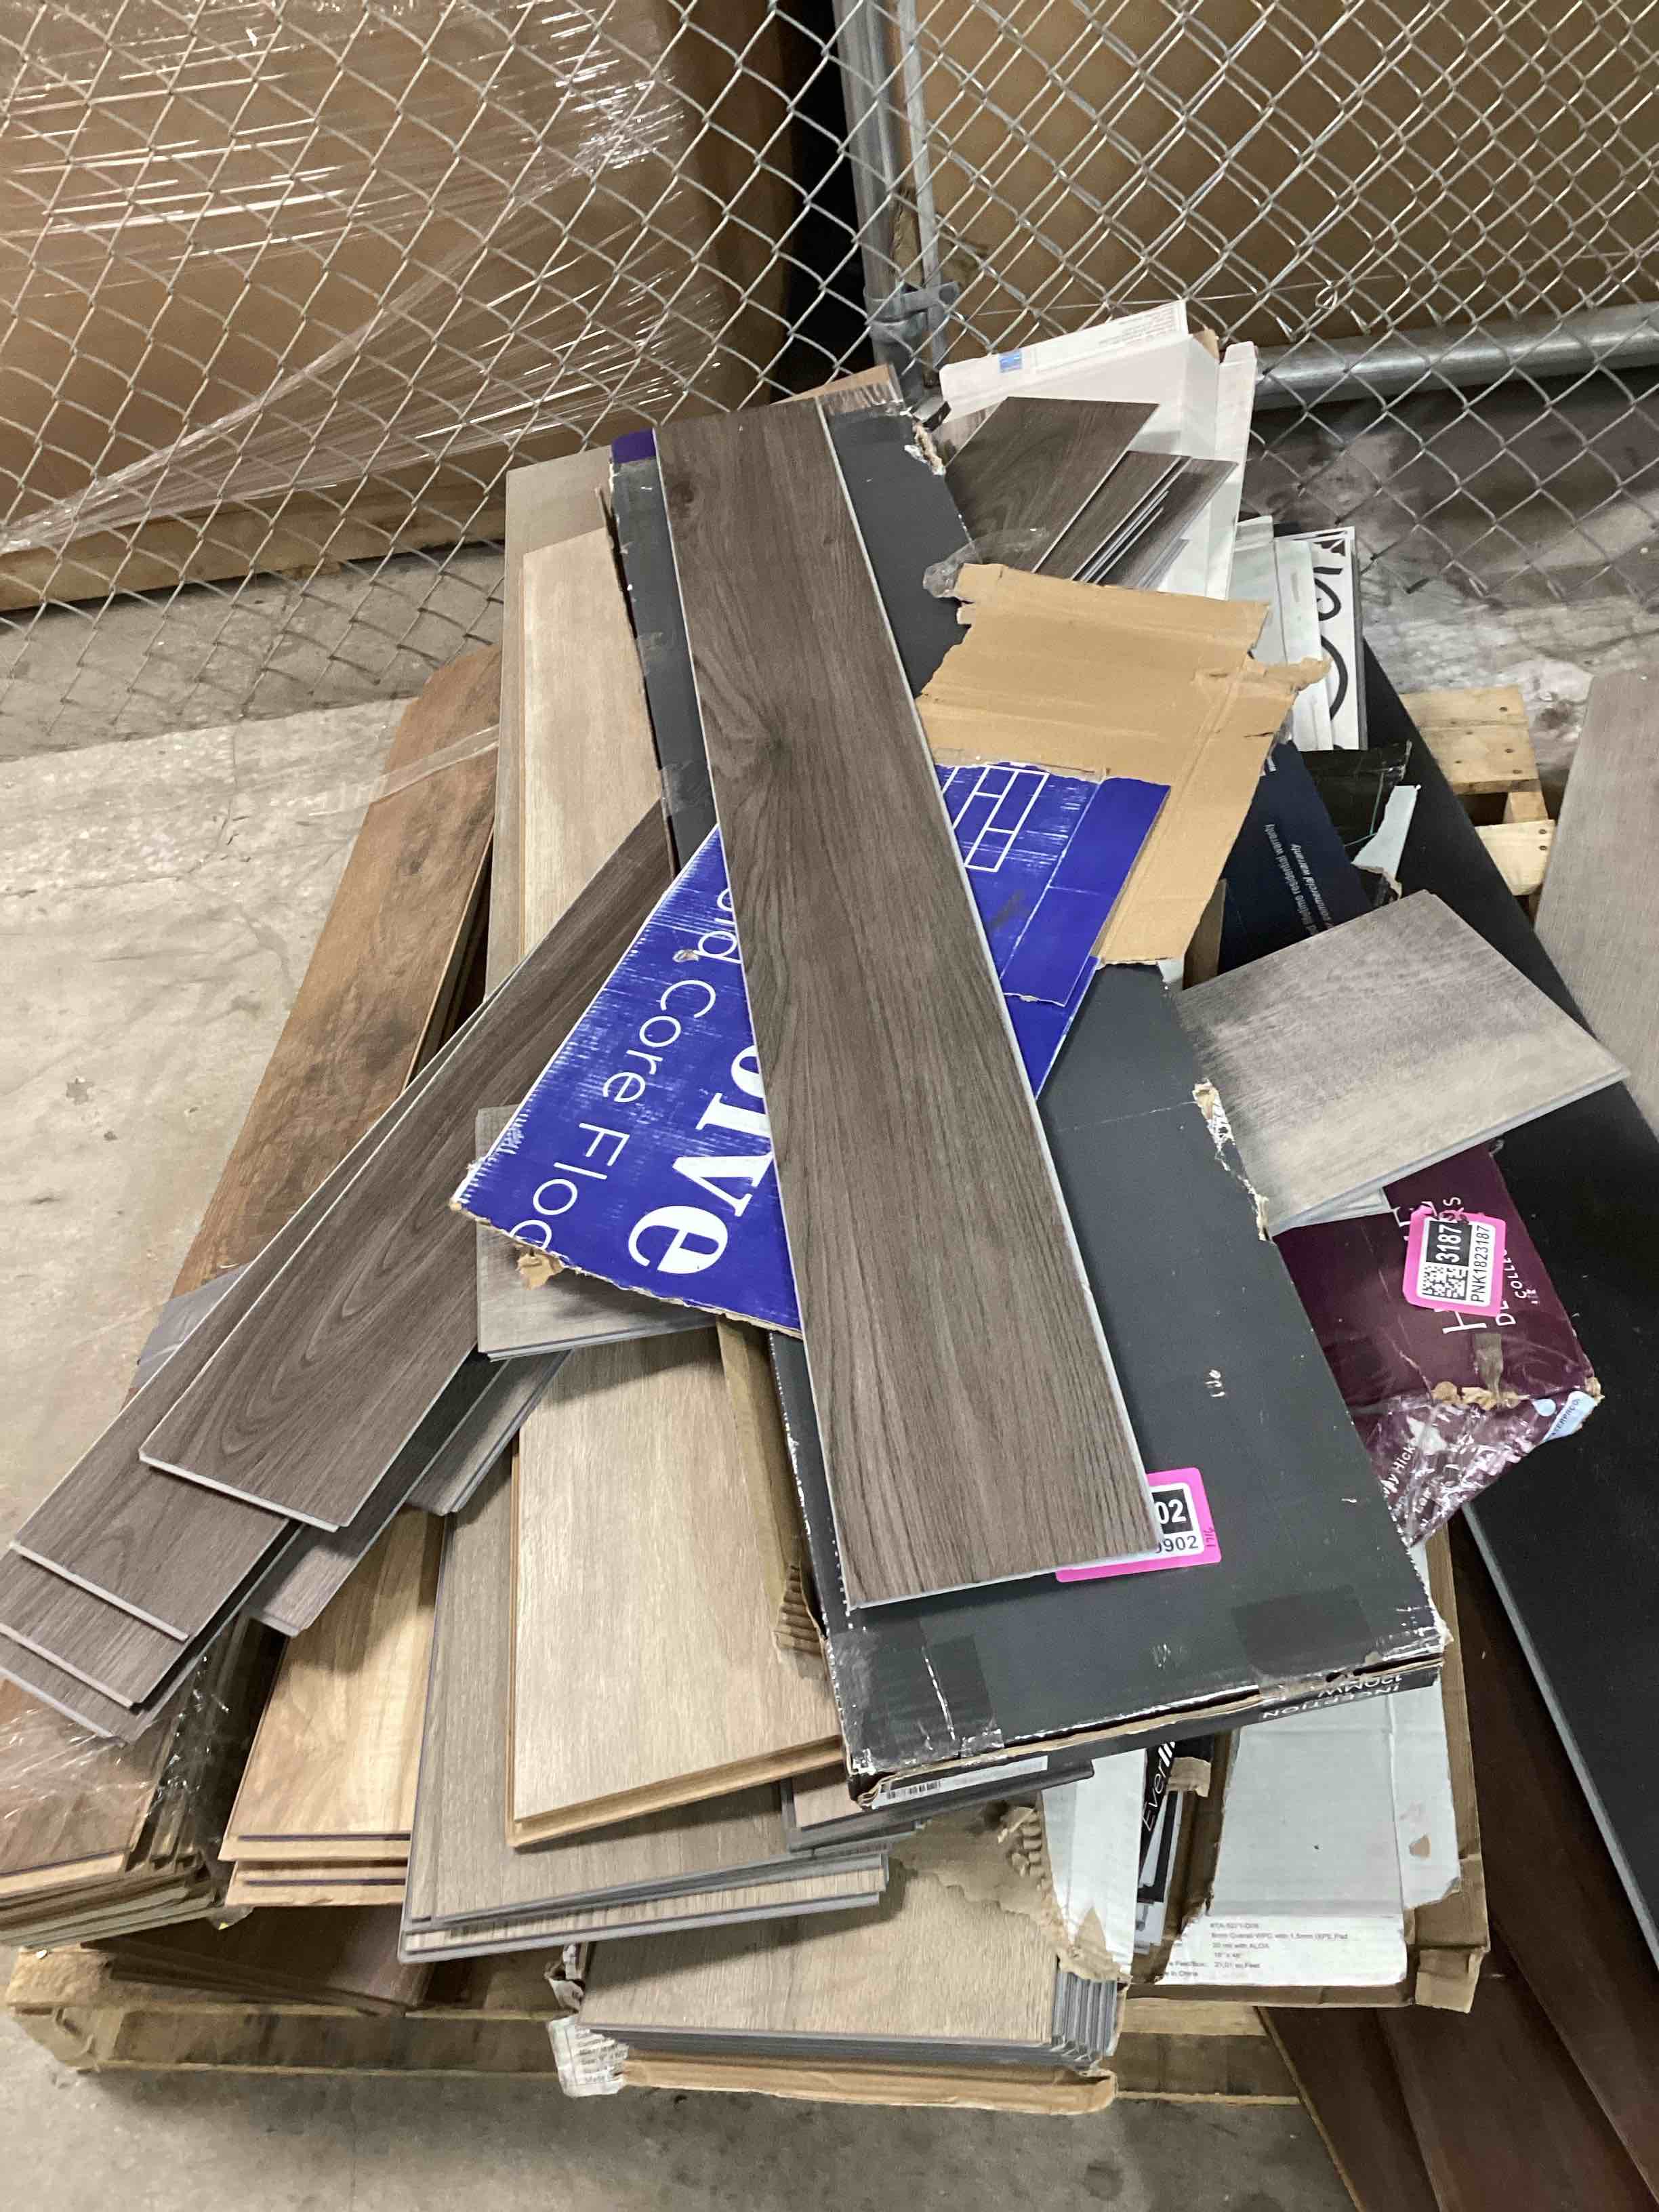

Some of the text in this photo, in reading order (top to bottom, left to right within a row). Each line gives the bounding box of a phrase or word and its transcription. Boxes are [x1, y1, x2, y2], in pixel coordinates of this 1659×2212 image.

[1290, 843, 1311, 876] warranty
[602, 979, 716, 1103] Core
[1435, 1223, 1462, 1263] 3187
[1469, 1225, 1490, 1303] PNK1823187
[1155, 1535, 1199, 1554] 902
[1263, 1684, 1400, 1719] INCEPTION
